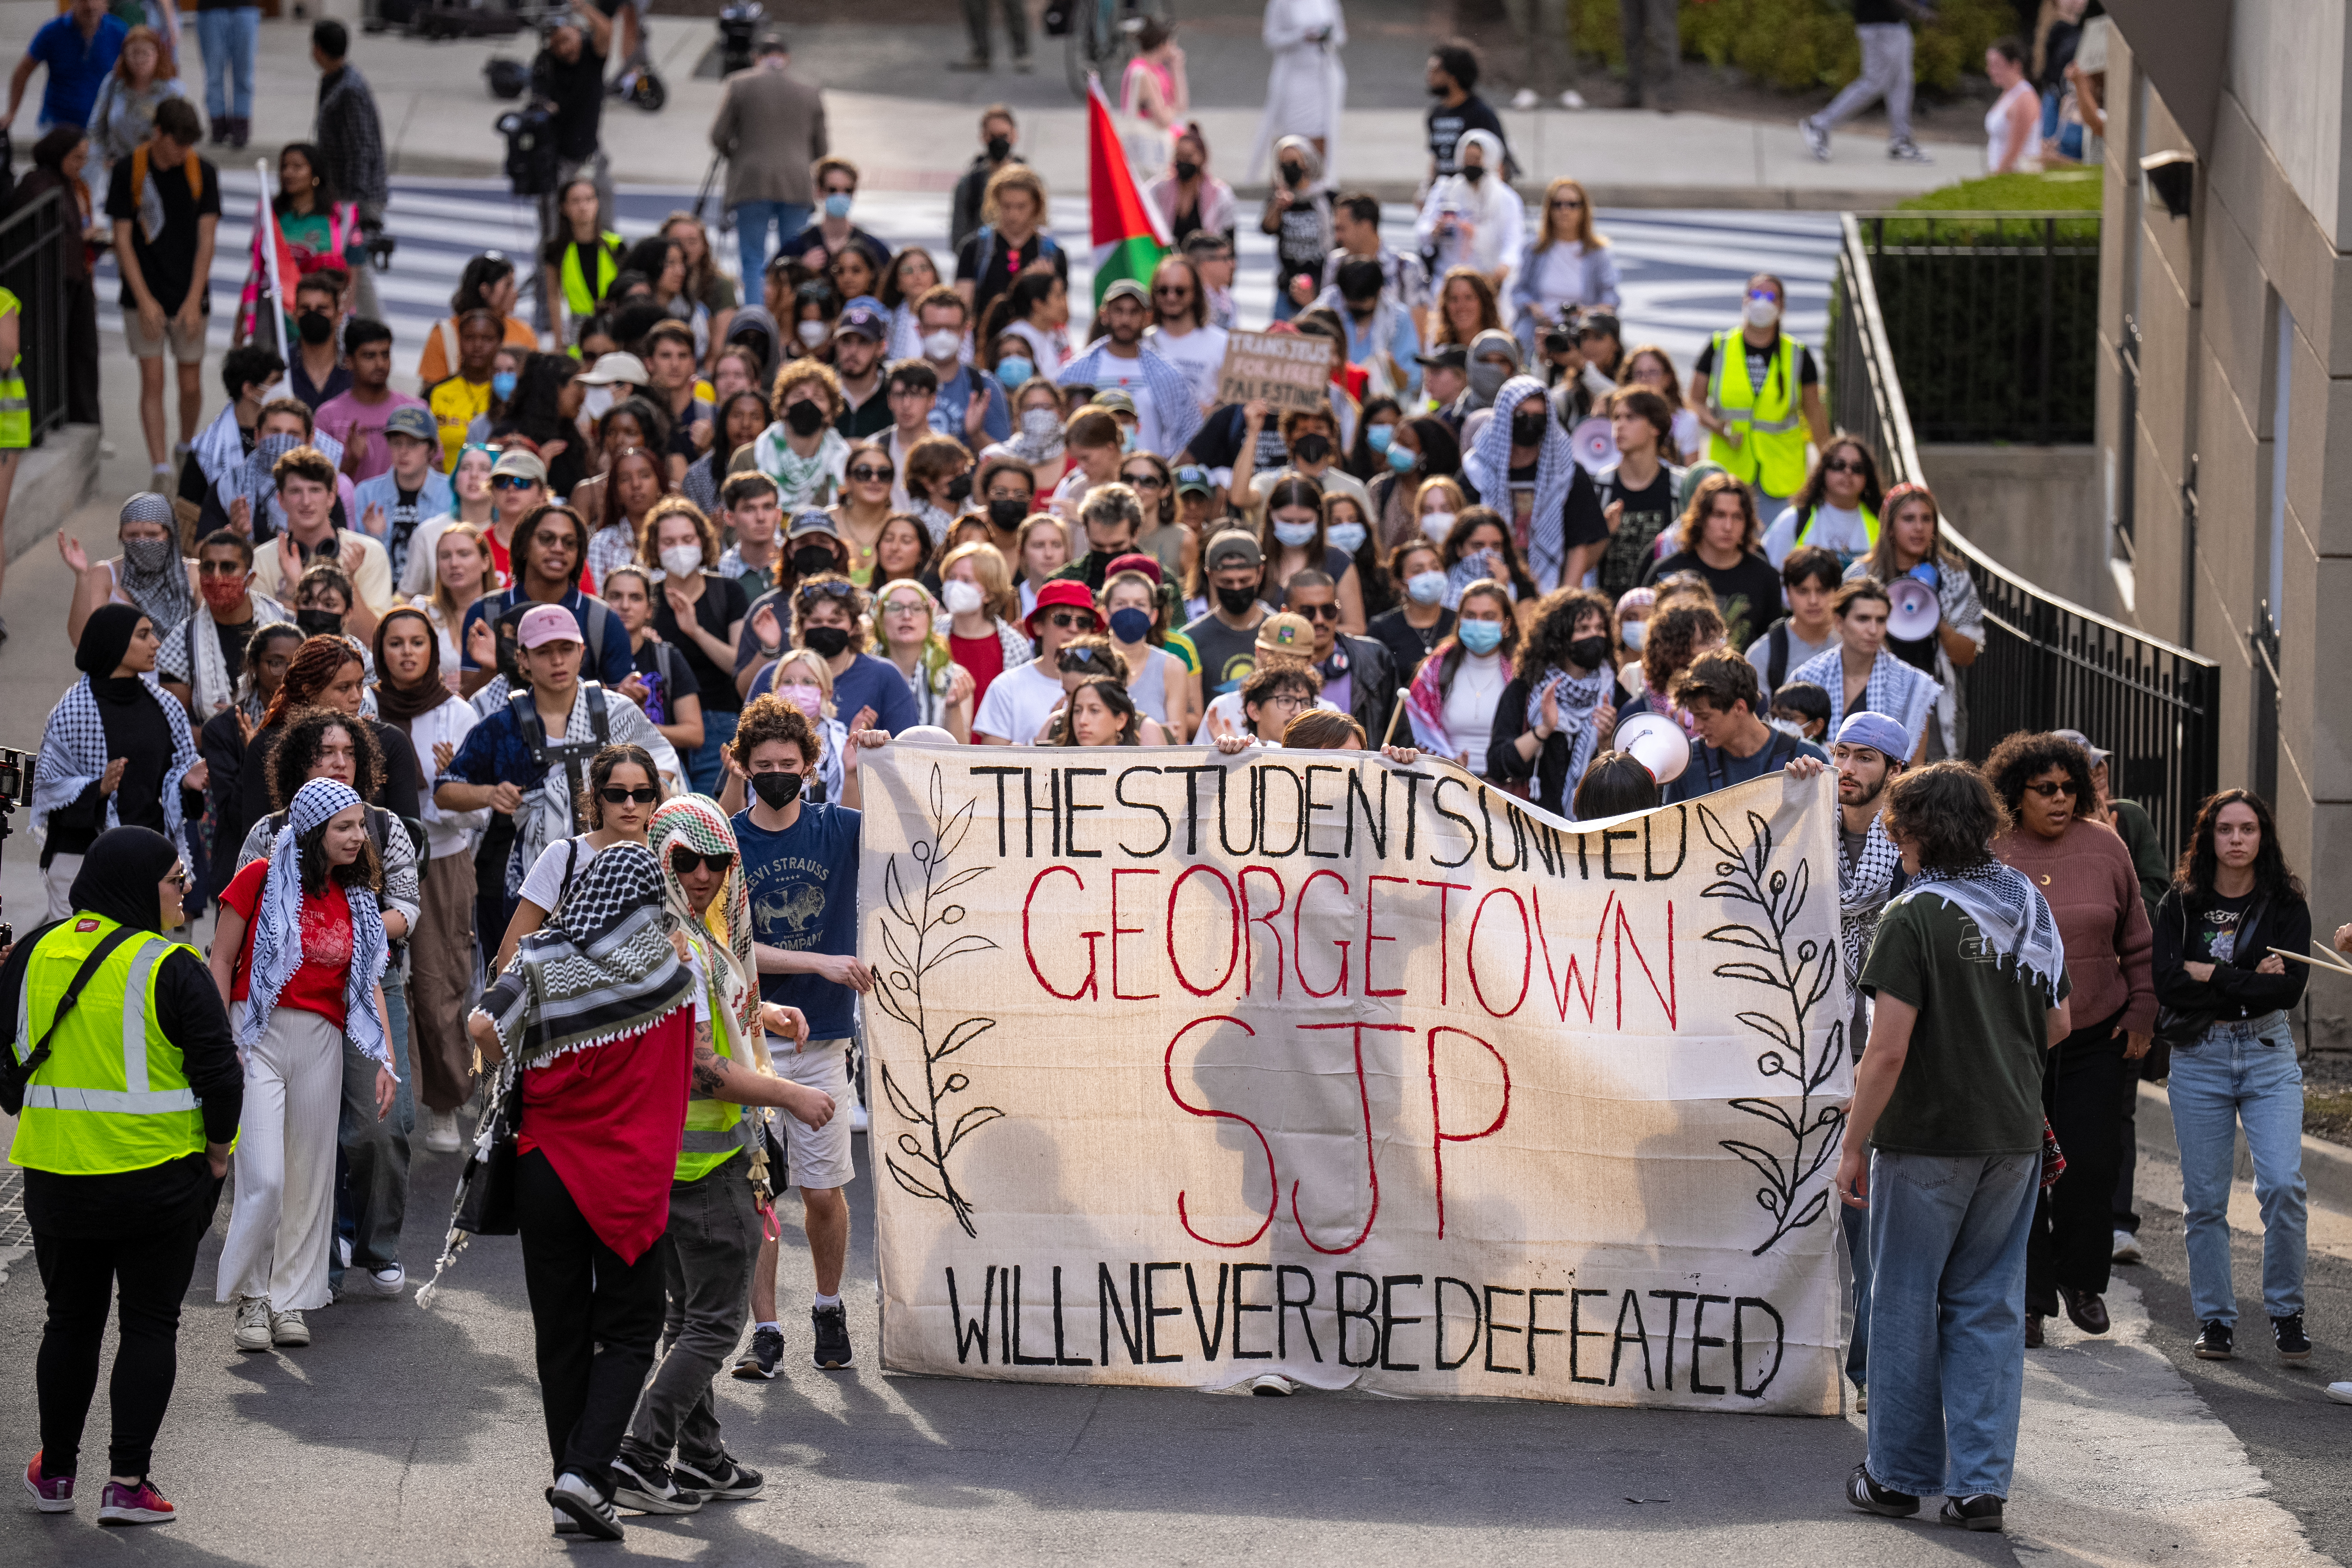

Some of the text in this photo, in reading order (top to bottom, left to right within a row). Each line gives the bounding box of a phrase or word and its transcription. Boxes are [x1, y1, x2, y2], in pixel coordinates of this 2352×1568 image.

[1230, 333, 1331, 365] TRANS JEWS
[1232, 356, 1324, 387] FOR A FREE
[1222, 376, 1320, 410] PALESTINE
[970, 765, 1106, 858] THE
[1116, 765, 1478, 870] STUDENTS
[773, 857, 829, 881] STRAUSS
[309, 910, 325, 921] THE
[1022, 864, 1676, 1031] GEORGETOWN
[1163, 1015, 1511, 1255] SJP
[945, 1262, 1785, 1401] WILL NEVER BE DEFEATED
